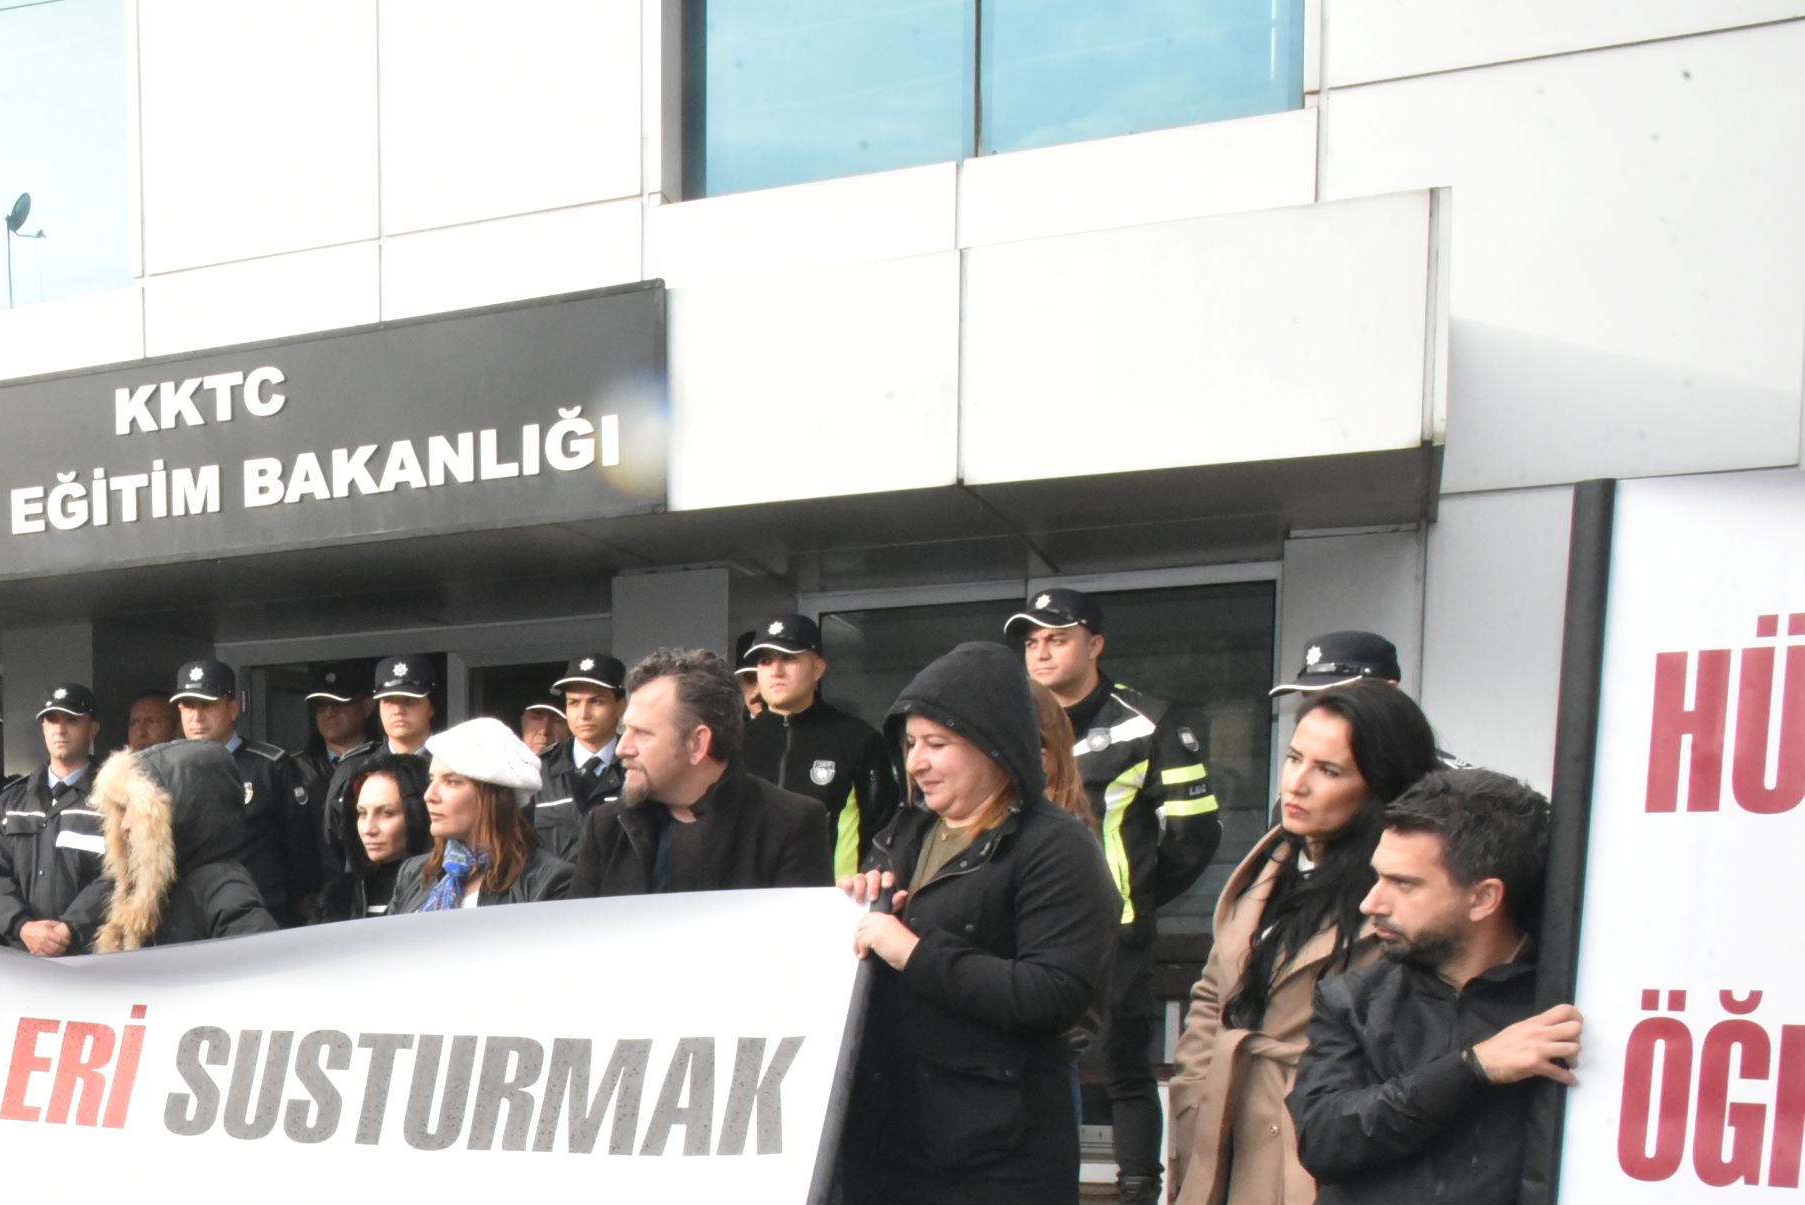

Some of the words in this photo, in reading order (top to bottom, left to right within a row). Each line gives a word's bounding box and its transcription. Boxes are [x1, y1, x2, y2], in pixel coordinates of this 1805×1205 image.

[114, 366, 287, 437] KKTC
[10, 458, 221, 537] EĞİTİM
[243, 406, 620, 509] BAKANLIĞI
[163, 1025, 806, 1157] SUSTURMAK
